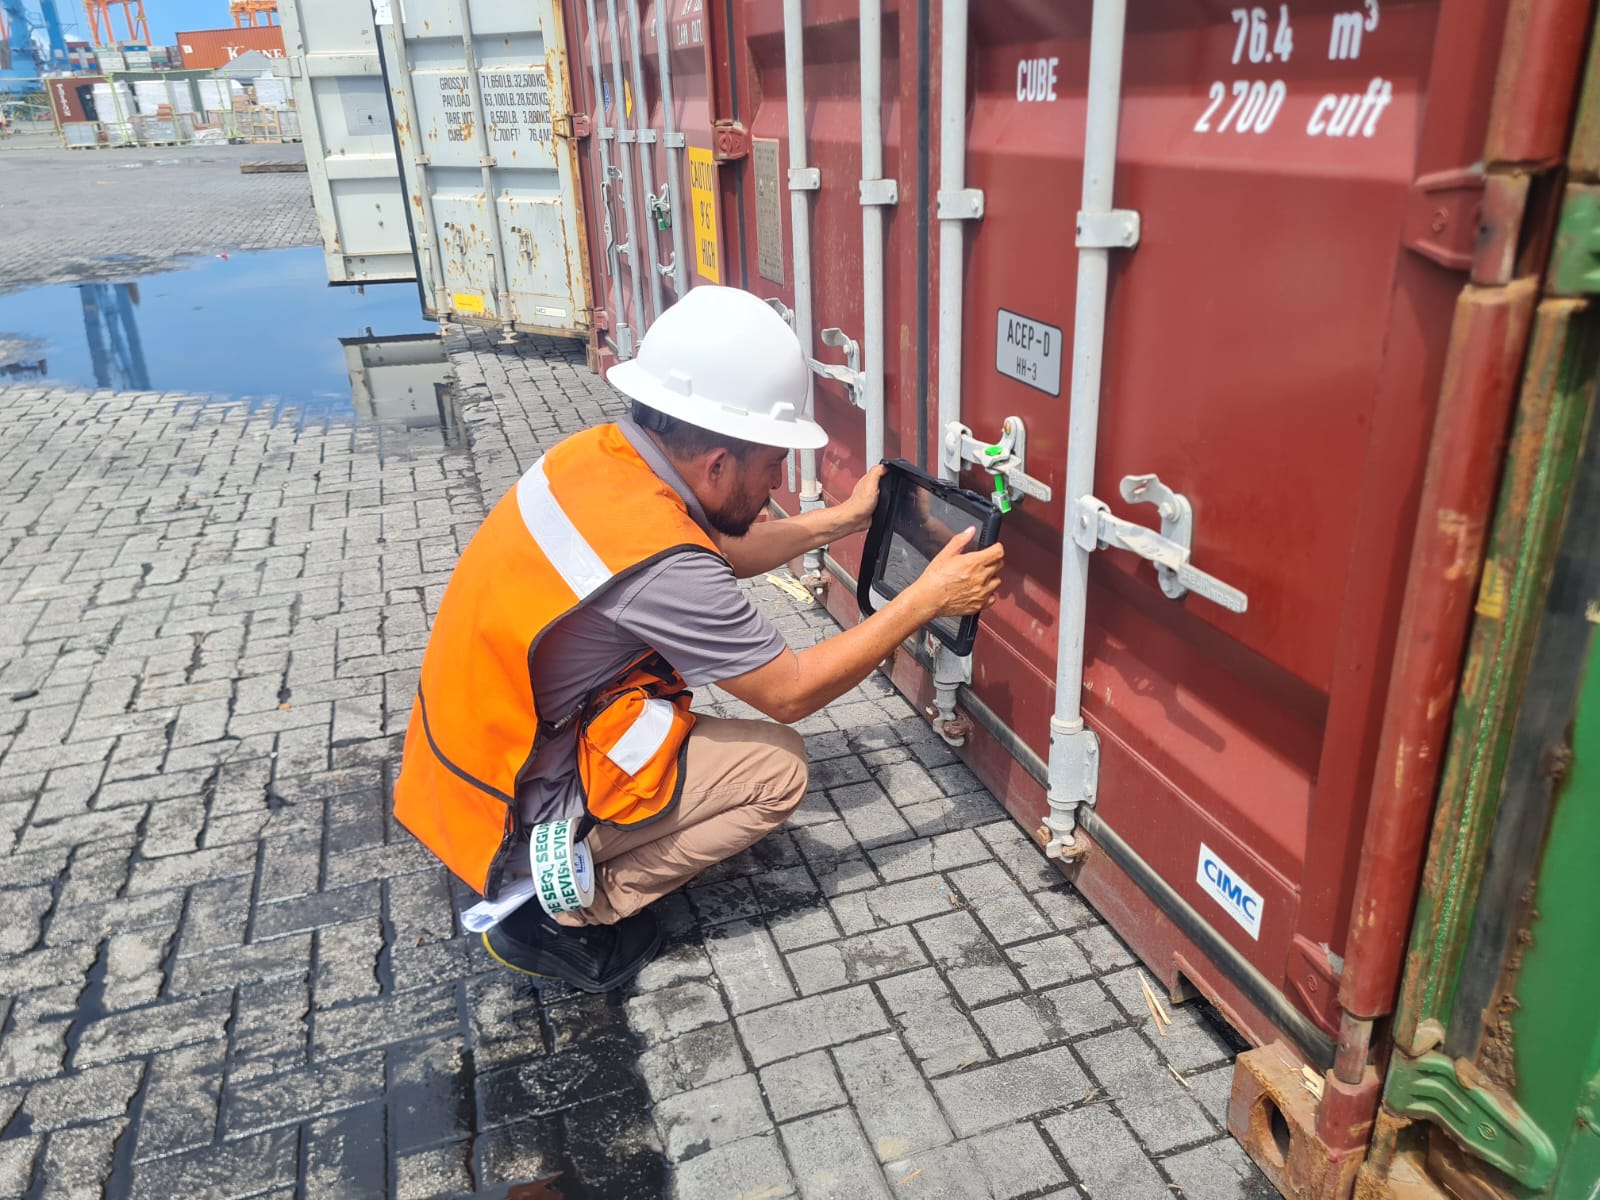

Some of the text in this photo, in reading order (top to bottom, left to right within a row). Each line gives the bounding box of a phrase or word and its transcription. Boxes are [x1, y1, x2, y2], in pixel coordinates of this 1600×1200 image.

[1231, 0, 1380, 65] 76.4 m³
[439, 77, 460, 90] GROSS
[1016, 57, 1059, 102] CUBE
[442, 94, 471, 108] PAYLOAD
[445, 112, 461, 124] TARE
[1306, 76, 1393, 138] cuft
[702, 238, 716, 269] HIGH
[1006, 319, 1051, 358] ACEP-D
[1016, 355, 1038, 381] HH-3
[1203, 858, 1257, 921] CIMC
